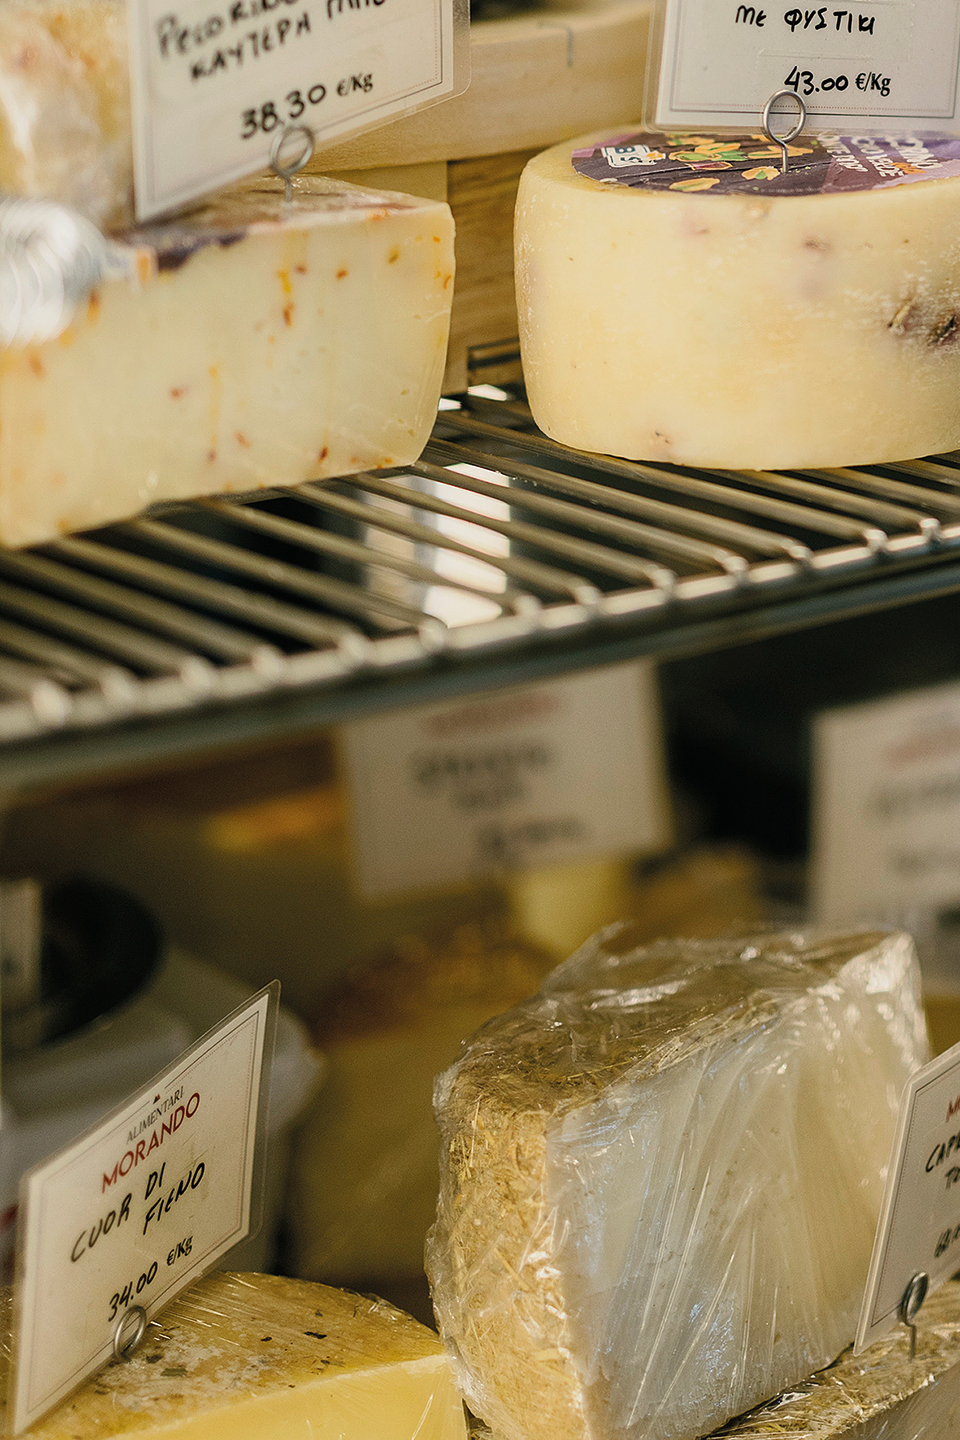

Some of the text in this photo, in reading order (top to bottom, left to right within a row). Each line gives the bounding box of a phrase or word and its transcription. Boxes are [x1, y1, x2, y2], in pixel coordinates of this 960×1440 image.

[784, 65, 892, 97] 43.00 €/Kg
[101, 1092, 201, 1195] MORANDO
[126, 1085, 185, 1145] ALIMENTARI
[70, 1162, 167, 1263] CUOR DI
[142, 1162, 206, 1236] FIENO
[107, 1235, 194, 1323] 34.00 €/Kg
